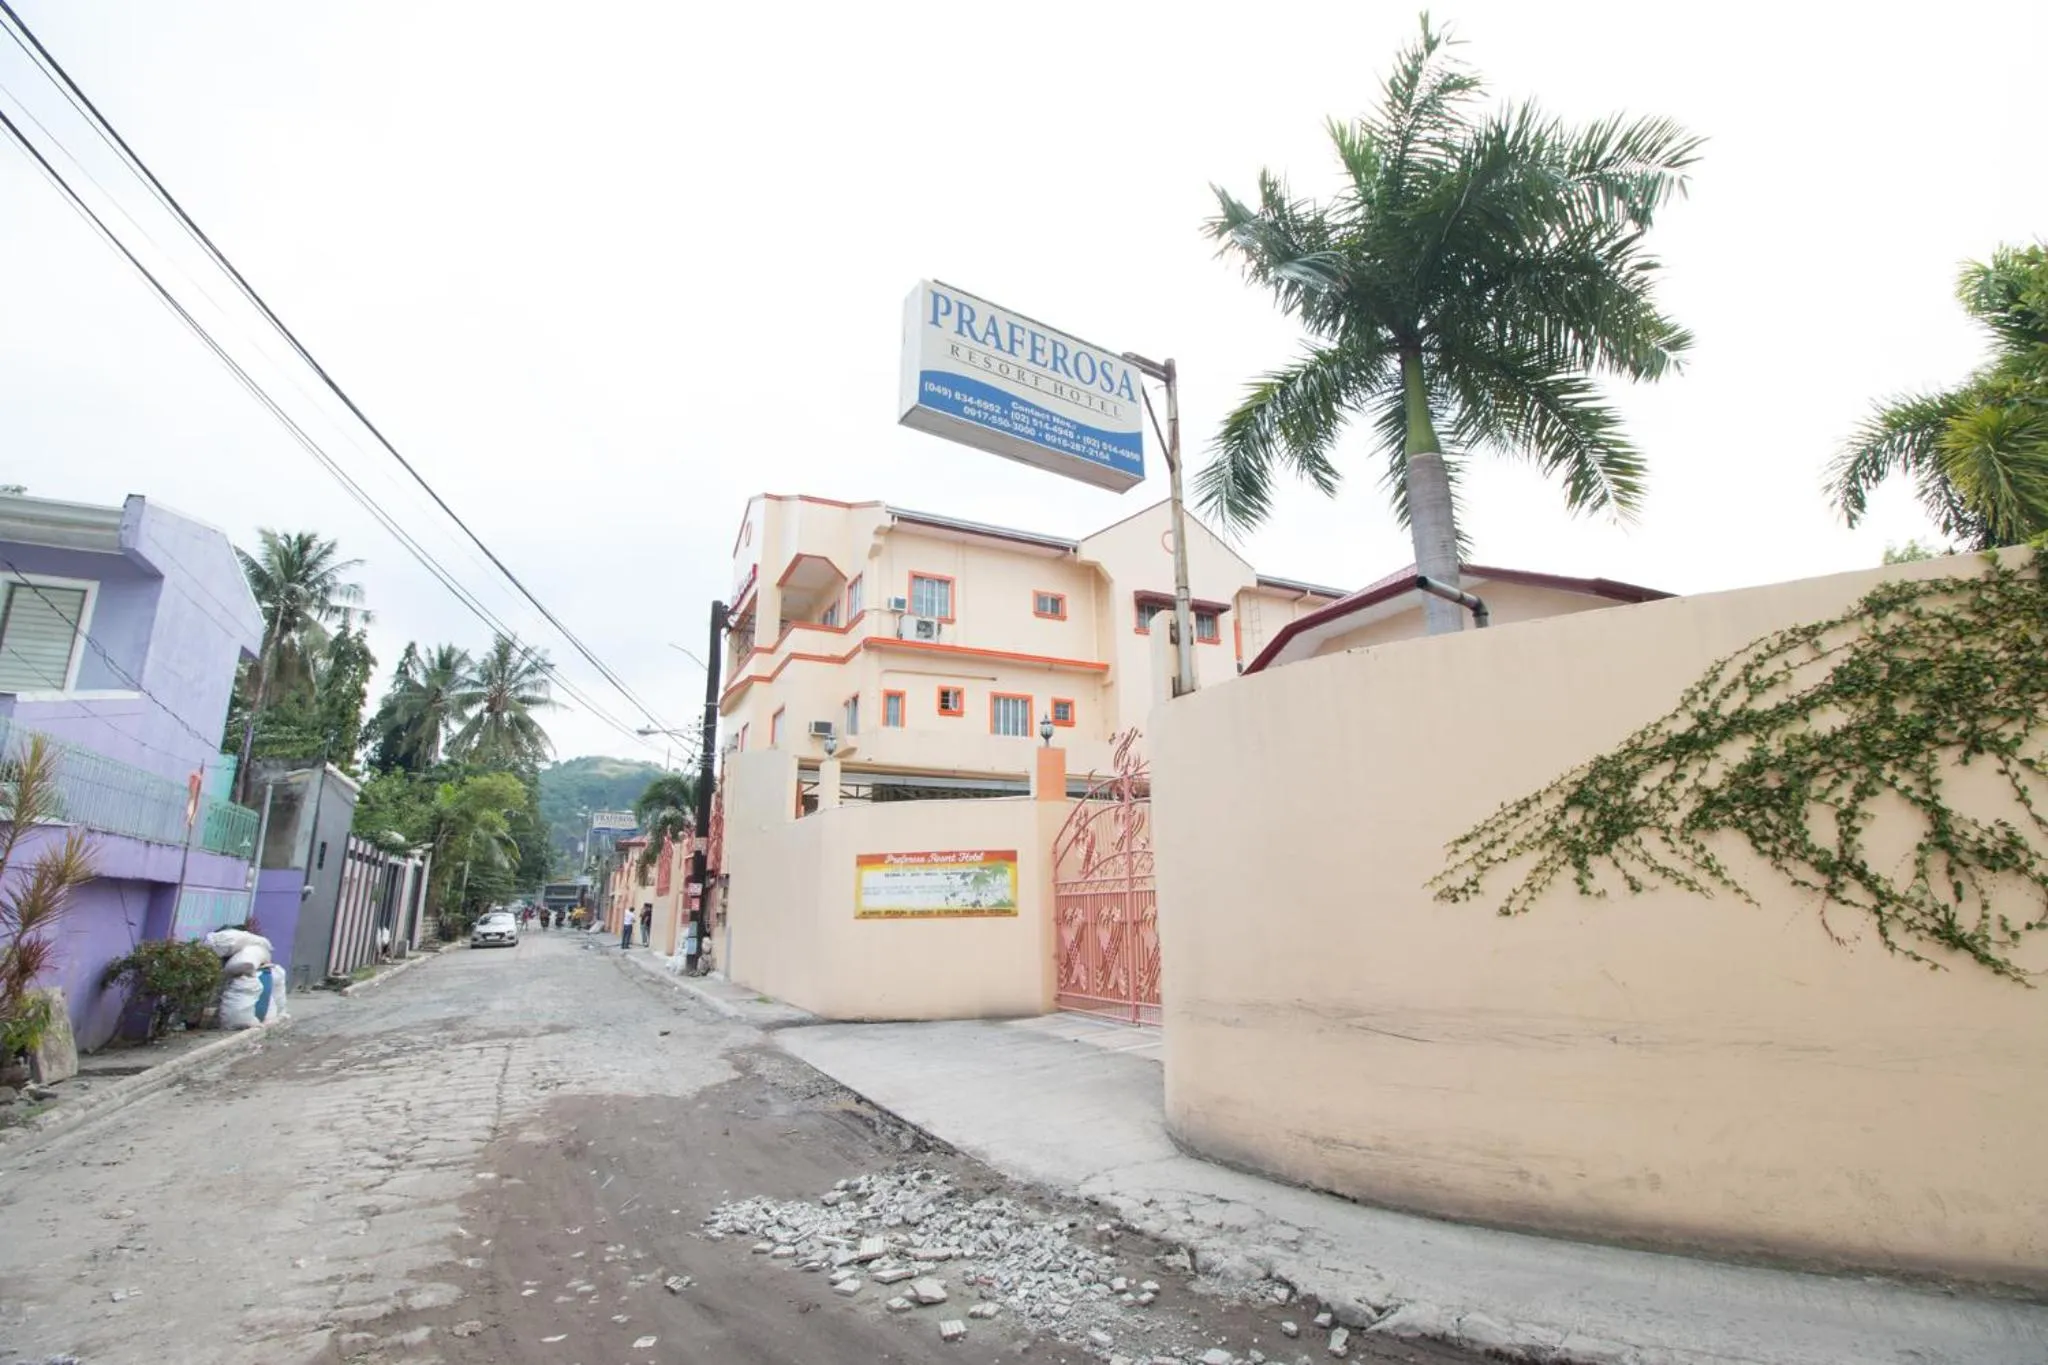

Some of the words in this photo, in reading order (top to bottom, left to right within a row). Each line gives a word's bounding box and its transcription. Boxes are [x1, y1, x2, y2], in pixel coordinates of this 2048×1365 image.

[929, 289, 1138, 404] PRAFEROSA
[950, 343, 1041, 387] RESORT
[1054, 382, 1123, 417] HOTEL
[958, 851, 985, 862] Hotel
